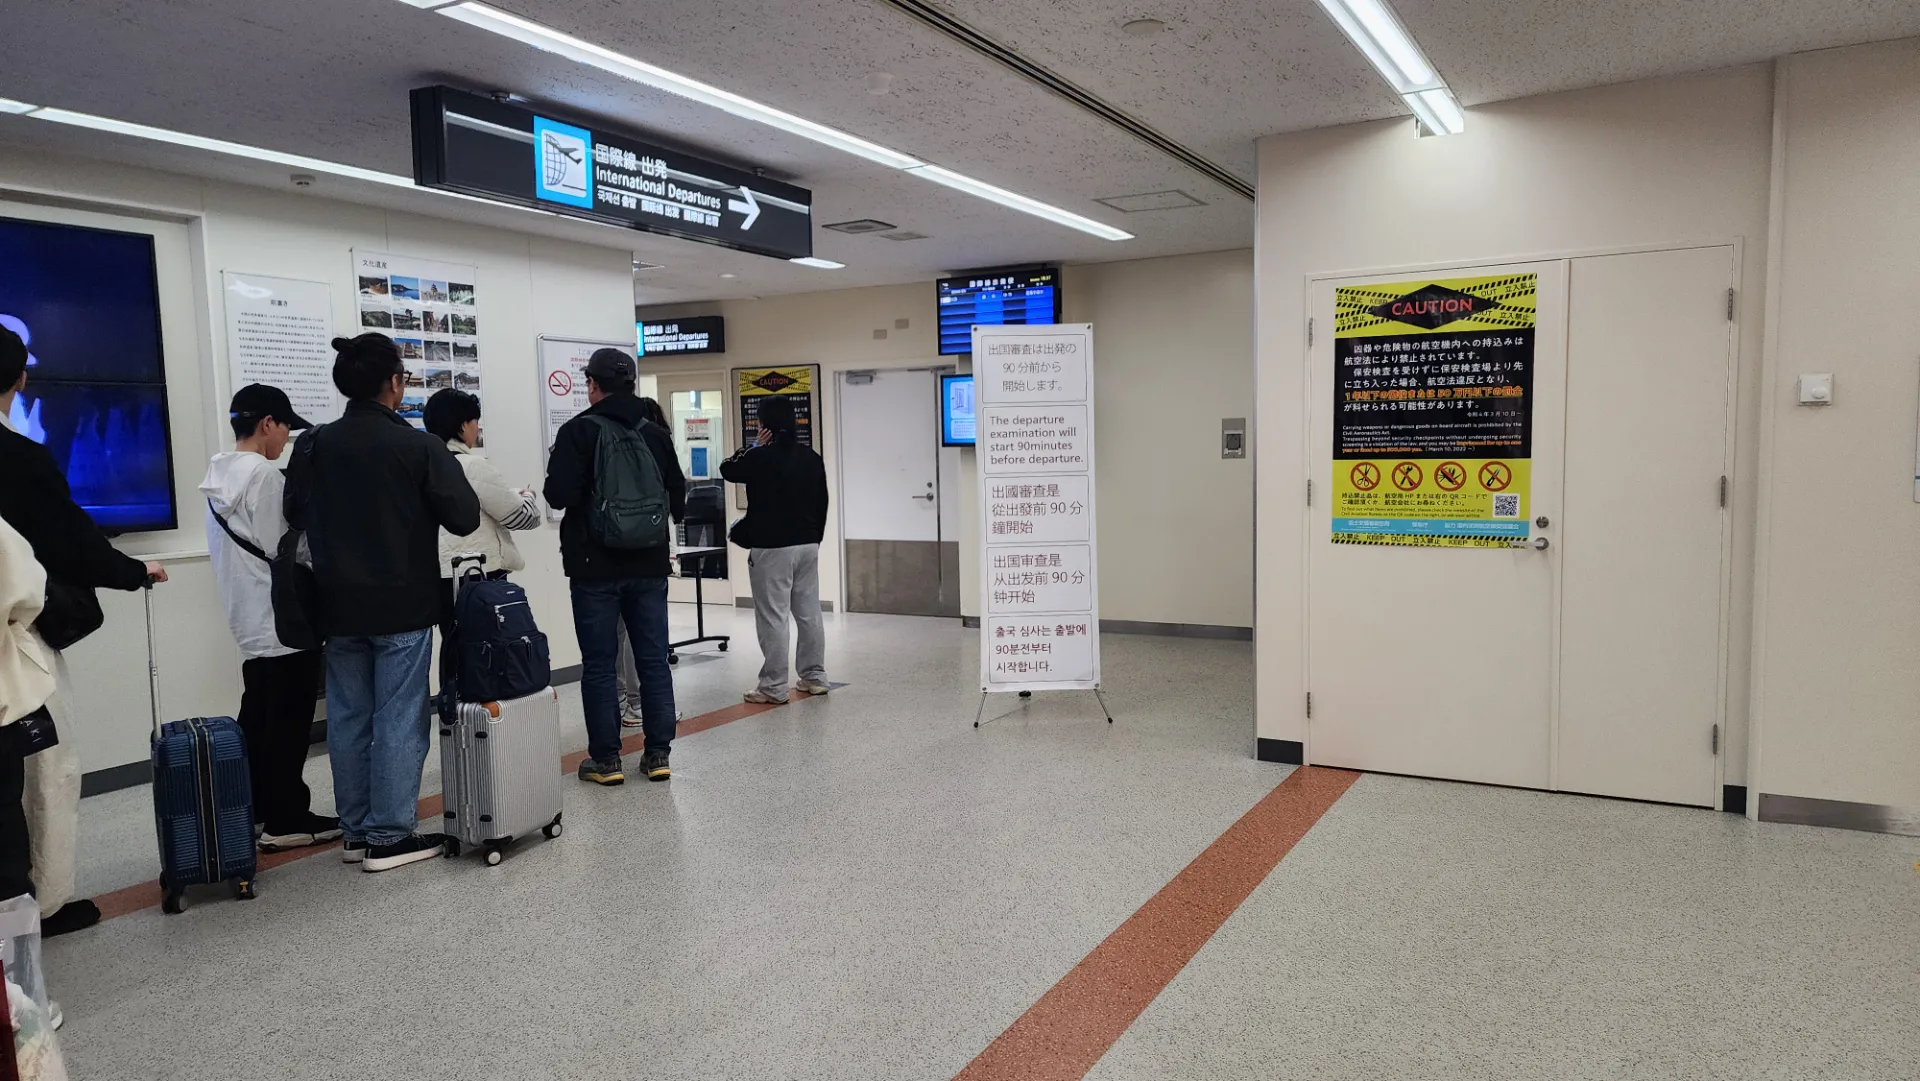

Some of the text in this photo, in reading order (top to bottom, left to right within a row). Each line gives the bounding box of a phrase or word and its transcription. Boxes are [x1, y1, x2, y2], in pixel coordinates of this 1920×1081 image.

[596, 143, 668, 179] 国際線 出発
[596, 166, 721, 209] International Departures
[1392, 298, 1472, 316] CAUTION
[679, 333, 709, 341] Departures
[988, 343, 1076, 355] 出国審査は出発の
[1344, 352, 1480, 366] 航空法により禁止されています。
[1353, 362, 1524, 377] 保安検査を受けずに保安検査場より先
[1002, 380, 1062, 392] 開始します。
[1344, 375, 1510, 388] に立ち入った場合、航空法違反となり、
[1344, 400, 1479, 412] が科せられる可能性があります。
[990, 415, 1064, 427] The departure
[990, 427, 1076, 438] examination will
[990, 441, 1072, 451] start 90minutes
[991, 454, 1083, 466] before departure.
[992, 521, 1033, 535] 鐘開始
[994, 554, 1062, 568] 出国审查是
[994, 589, 1035, 604] 钟开始
[996, 623, 1087, 637] 출국 심사는 출발에
[996, 643, 1051, 655] 90분전부터
[996, 661, 1052, 673] 시작합니다.
